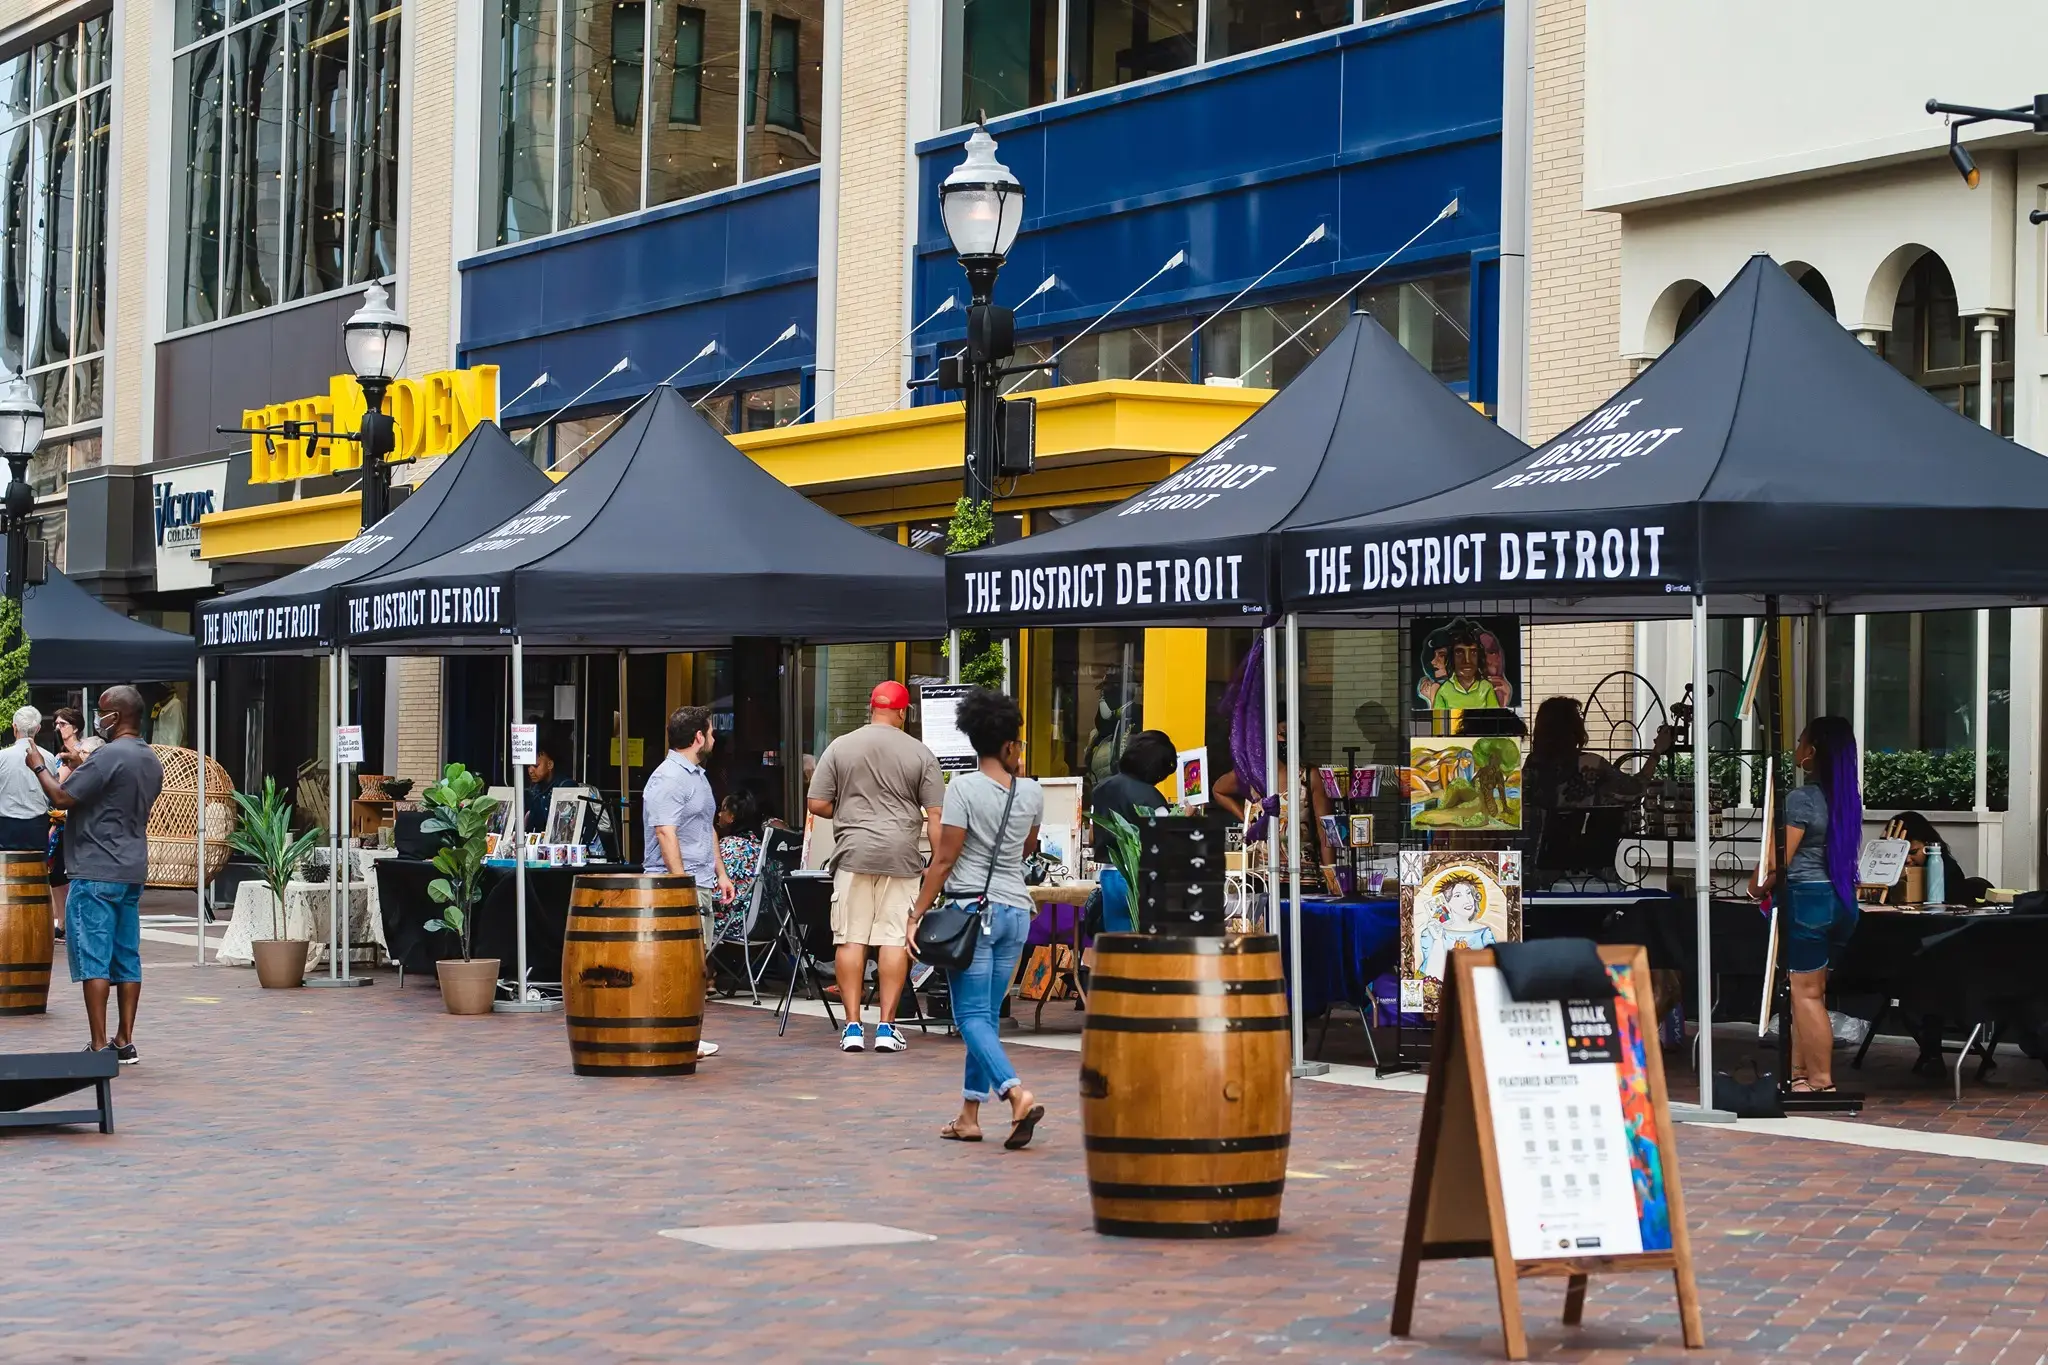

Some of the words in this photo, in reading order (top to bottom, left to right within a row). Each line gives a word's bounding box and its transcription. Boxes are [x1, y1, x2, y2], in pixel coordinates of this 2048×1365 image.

[241, 396, 331, 485] THE
[389, 365, 499, 462] DEN
[1572, 398, 1643, 438] THE
[1190, 433, 1248, 468] THE
[1526, 427, 1684, 470] DISTRICT
[1148, 463, 1277, 497] DISTRICT
[1491, 462, 1622, 490] DETROIT
[153, 481, 214, 547] VICTORS
[1117, 493, 1221, 517] DETROIT
[167, 527, 201, 543] COLLECT
[488, 515, 571, 539] DISTRICT
[1305, 545, 1352, 595] THE
[1362, 533, 1487, 590] DISTRICT
[1500, 526, 1665, 580] DETROIT
[965, 571, 1001, 613] THE
[1010, 563, 1106, 611] DISTRICT
[1116, 555, 1242, 605] DETROIT
[203, 613, 219, 645] THE
[222, 608, 264, 643] DISTRICT
[267, 603, 321, 640] DETROIT
[349, 597, 369, 633] THE
[373, 589, 426, 630] DISTRICT
[431, 586, 500, 624] DETROIT
[1499, 1008, 1552, 1024] DISTRICT
[1568, 1006, 1607, 1023] WALK
[1571, 1023, 1613, 1037] SERIES
